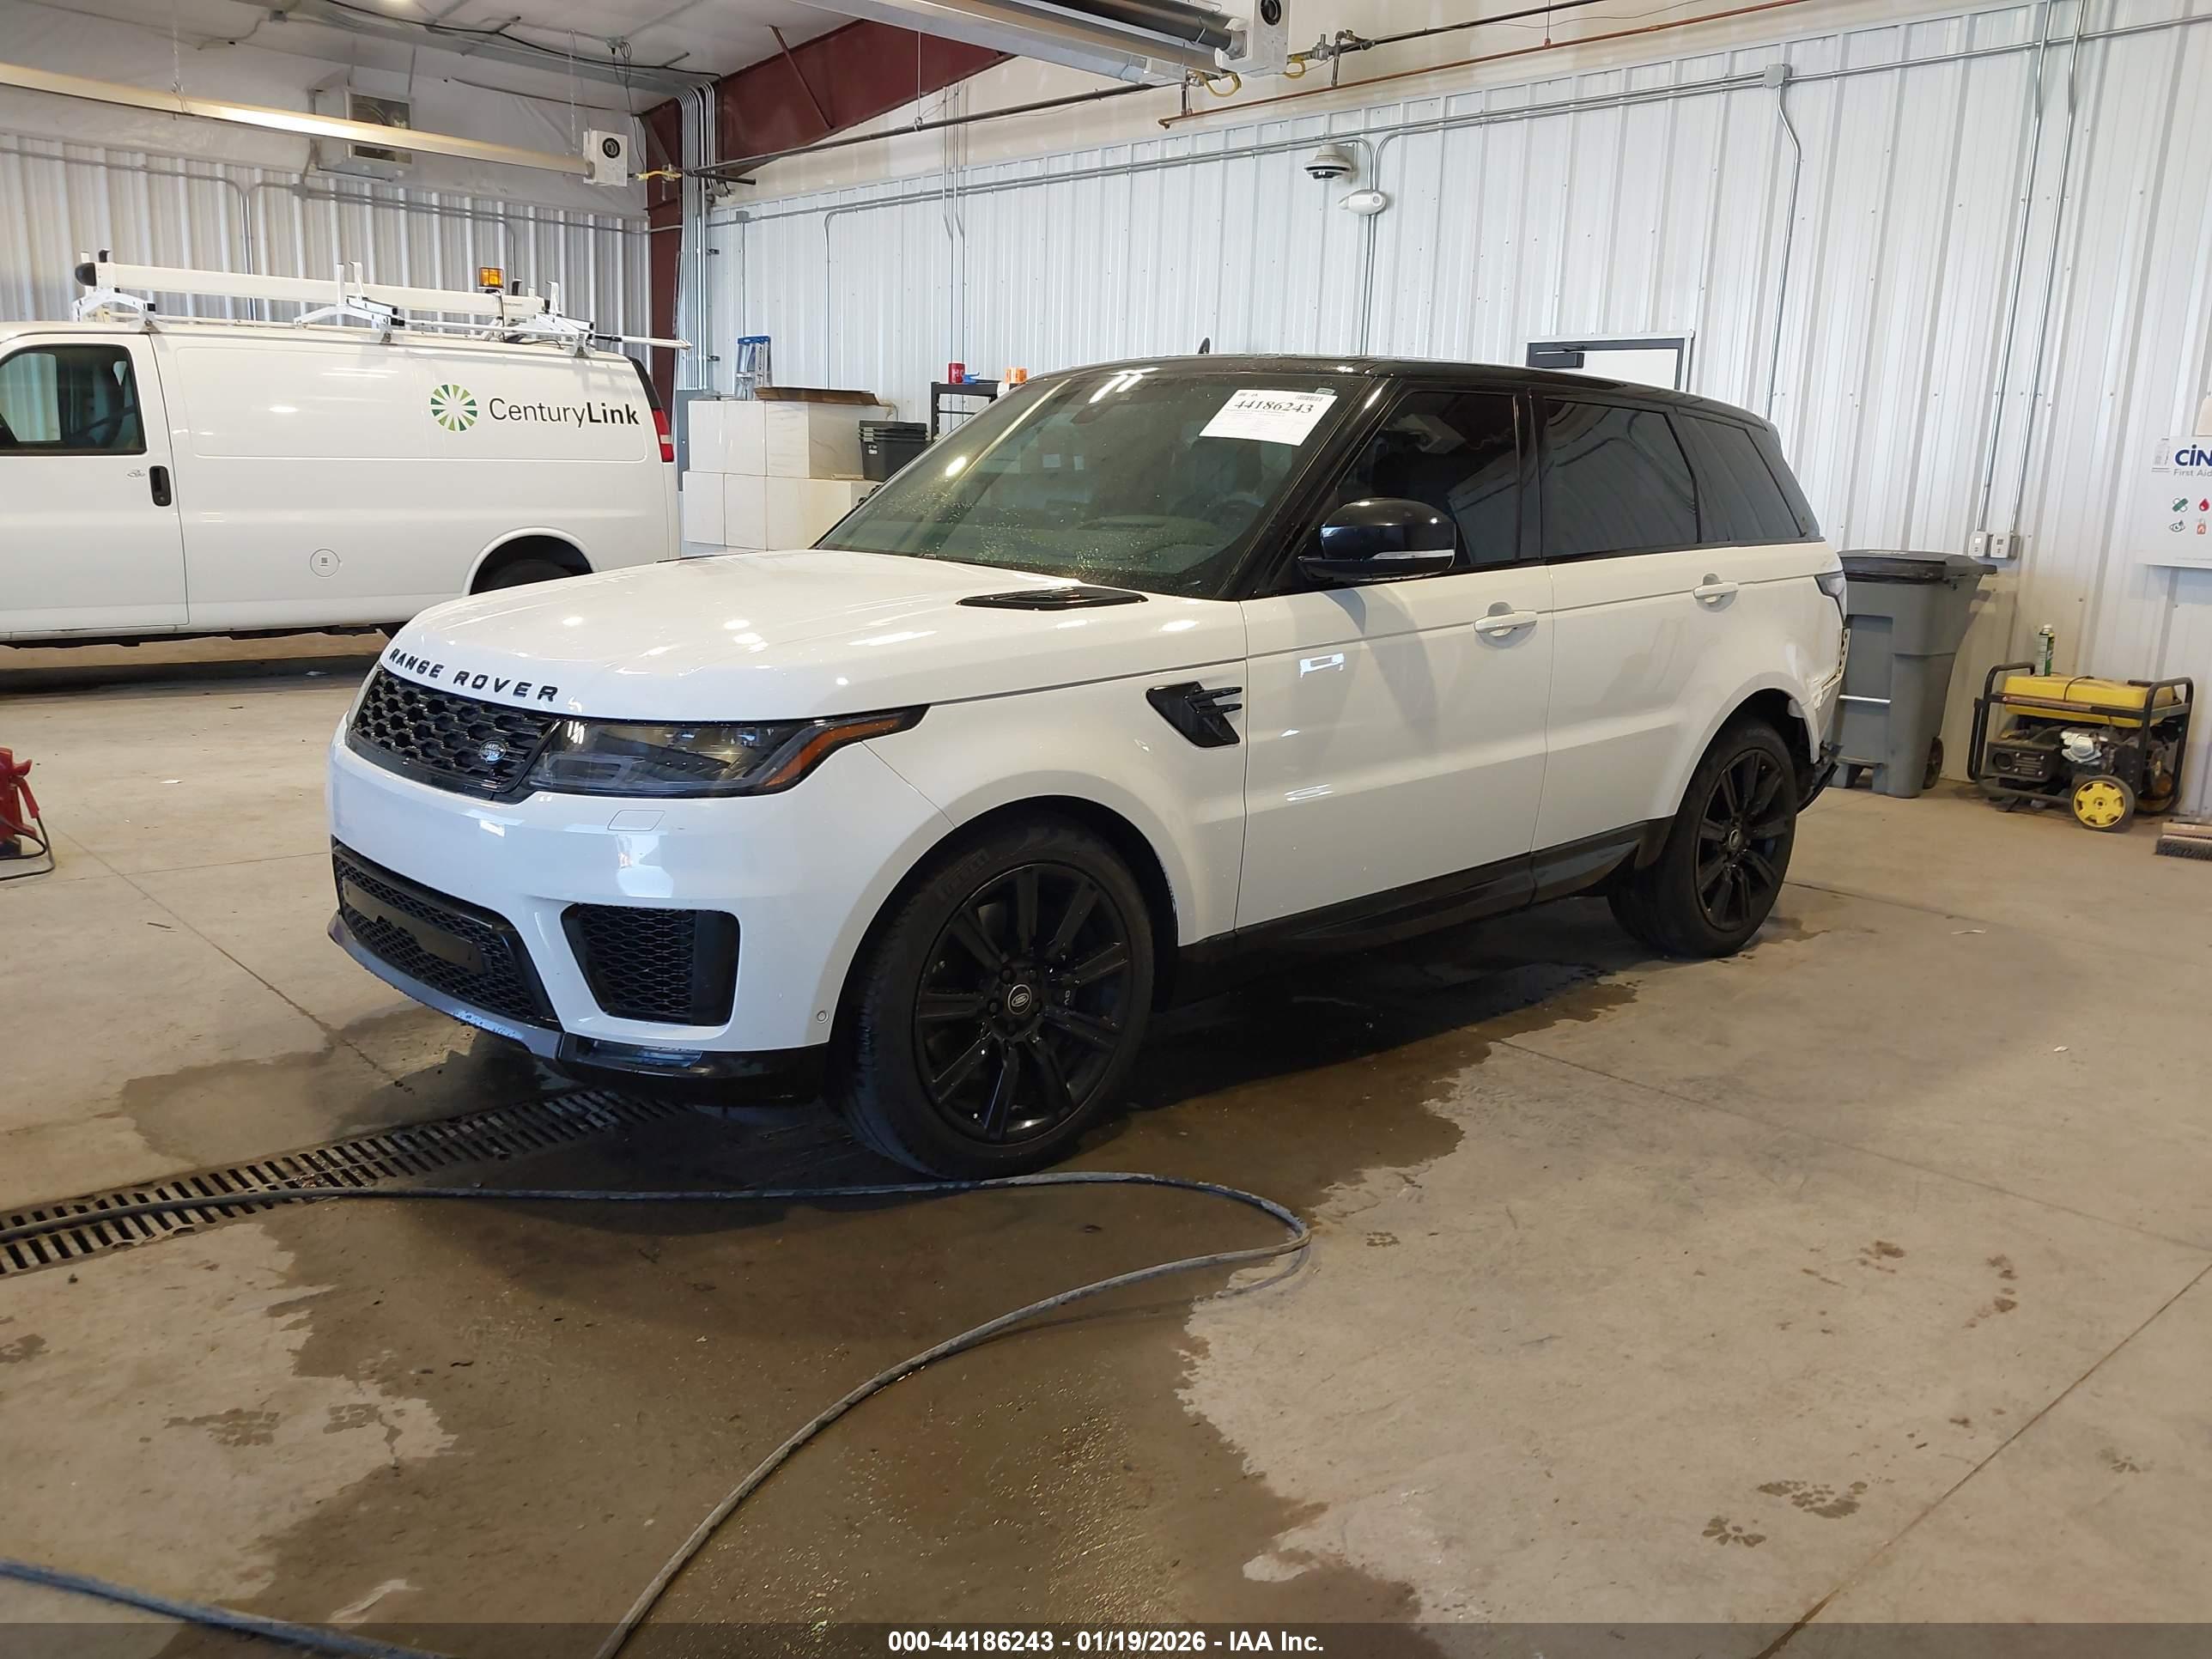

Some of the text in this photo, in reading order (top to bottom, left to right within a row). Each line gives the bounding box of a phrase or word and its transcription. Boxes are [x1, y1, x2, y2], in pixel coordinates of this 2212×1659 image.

[489, 398, 641, 428] CenturyLink
[1234, 400, 1314, 413] 44186243
[389, 648, 558, 702] RANGE ROVER
